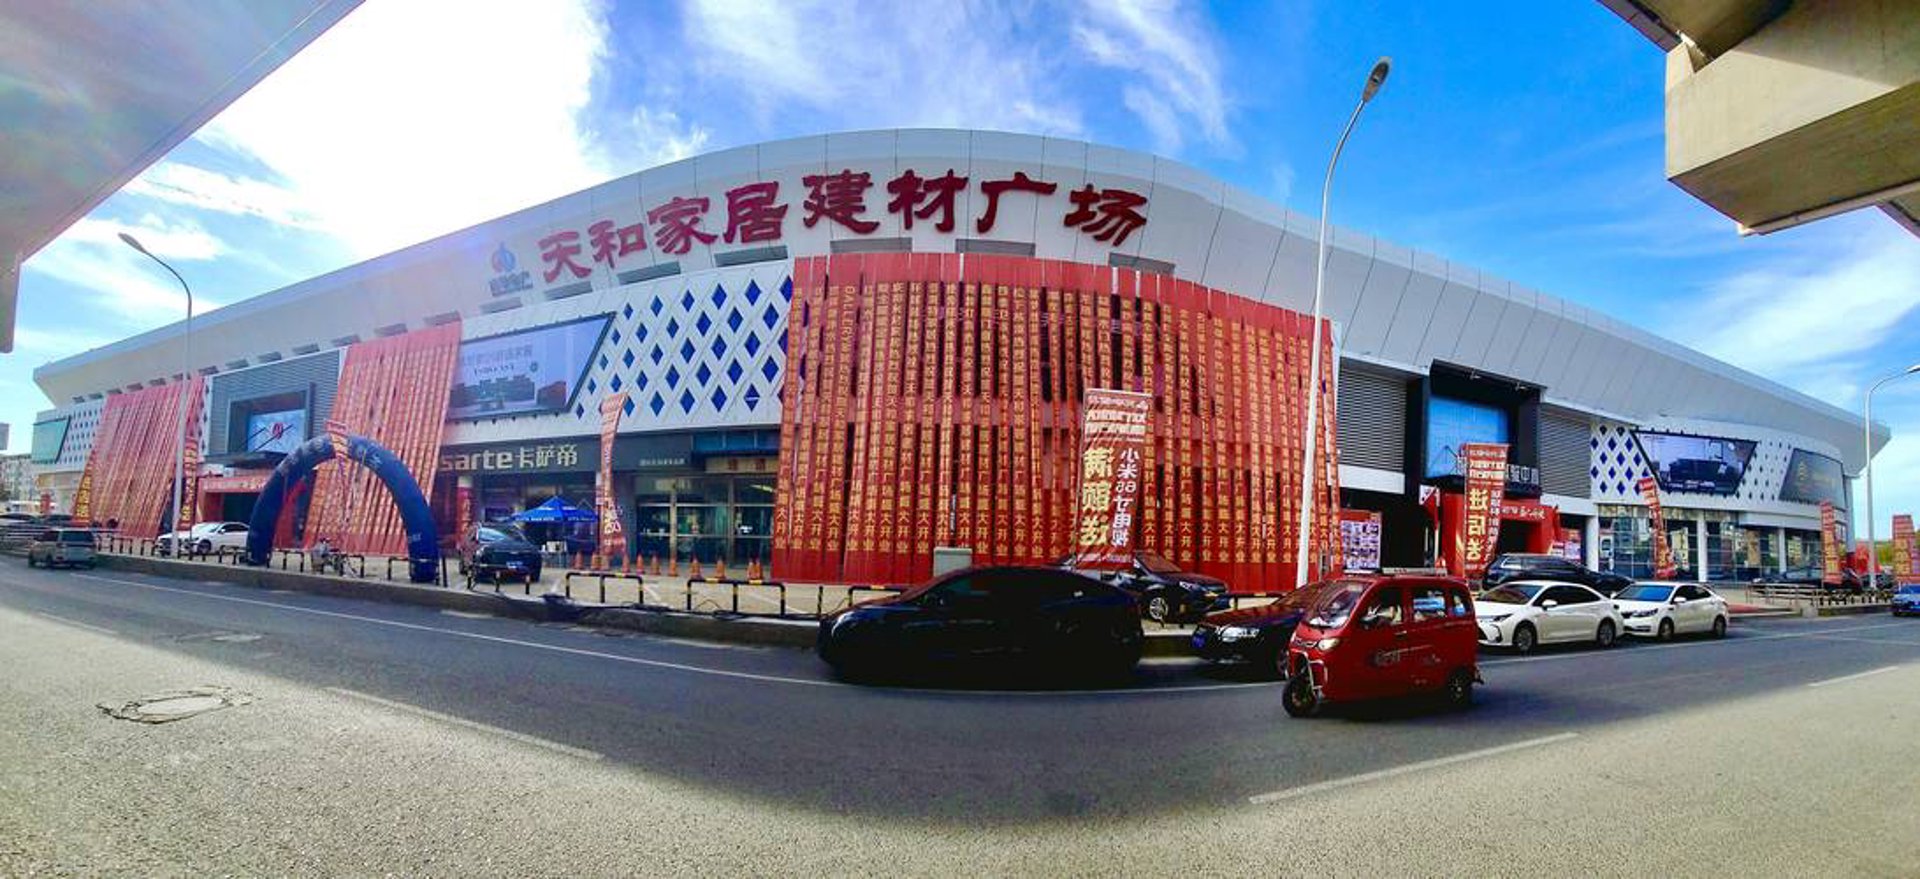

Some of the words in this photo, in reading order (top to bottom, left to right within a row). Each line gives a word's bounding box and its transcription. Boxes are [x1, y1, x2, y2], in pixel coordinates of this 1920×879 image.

[539, 168, 1148, 283] 天和家居建材广场
